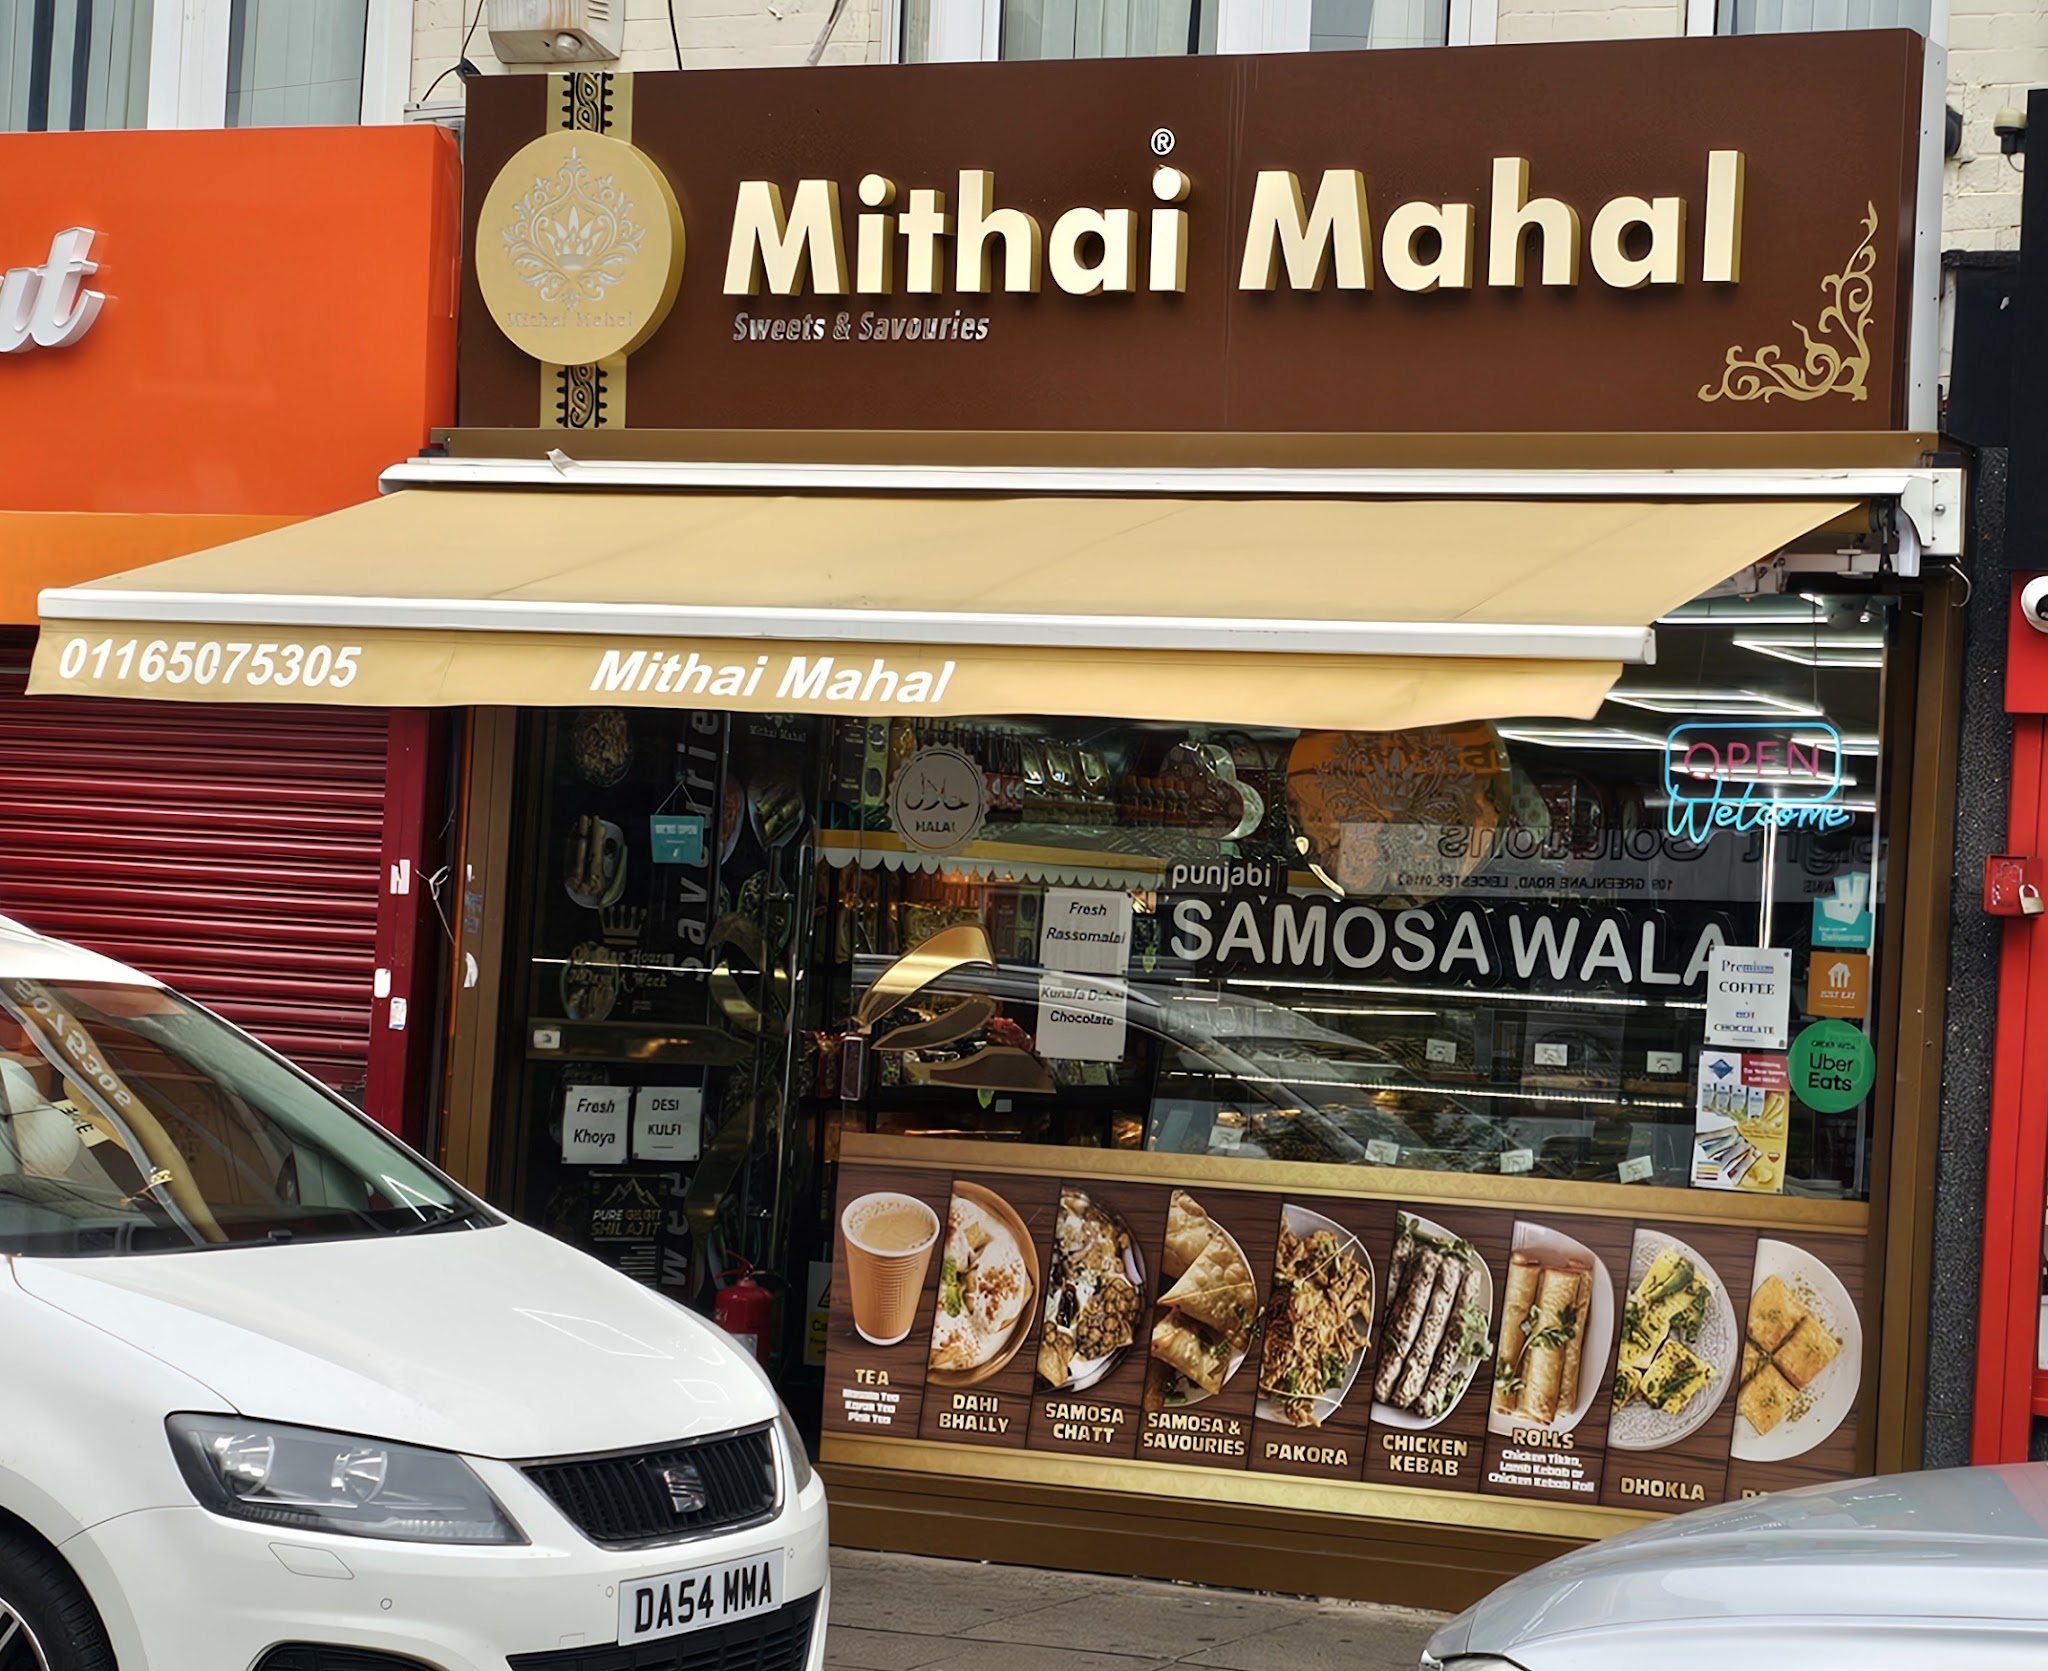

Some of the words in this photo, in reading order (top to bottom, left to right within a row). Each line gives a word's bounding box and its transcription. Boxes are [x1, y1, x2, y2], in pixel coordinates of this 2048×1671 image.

[723, 165, 1191, 296] Mithai
[1238, 150, 1746, 294] Mahal
[507, 312, 567, 328] Mithai
[576, 311, 633, 328] Mahal
[732, 311, 825, 342] Sweets
[832, 311, 852, 341] &
[858, 309, 991, 341] Savouries
[58, 637, 362, 689] 01165075305
[589, 650, 769, 697] Mithai
[776, 655, 956, 703] Mahal
[1683, 741, 1820, 781] OPEN
[1667, 773, 1850, 845] Welcome
[1171, 862, 1272, 892] punjabi
[1069, 902, 1108, 917] Fresh
[1171, 899, 1491, 976] SAMOSA
[1508, 915, 1726, 988] WALA
[1721, 959, 1775, 975] Premium
[1719, 981, 1776, 996] COFFEE
[1050, 1010, 1115, 1026] Chocolate
[1713, 1023, 1776, 1036] CHOCOLATE
[1809, 1052, 1854, 1073] Uber
[1808, 1072, 1852, 1092] Eats
[576, 1098, 616, 1114] Fresh
[651, 1098, 680, 1112] DESI
[573, 1128, 616, 1147] Khoya
[648, 1123, 682, 1137] KULFI
[592, 1208, 624, 1222] PURE
[855, 1368, 890, 1386] TEA
[952, 1393, 999, 1413] DAHI
[1045, 1402, 1125, 1425] SAMOSA
[938, 1412, 1010, 1435] BHALLY
[1052, 1423, 1116, 1444] CHATT
[1147, 1412, 1224, 1435] SAMOSA
[1227, 1418, 1241, 1436] &
[1142, 1433, 1246, 1457] SAVOURIES
[1382, 1433, 1468, 1458] CHICKEN
[1512, 1427, 1575, 1450] ROLLS
[1265, 1442, 1349, 1467] PAKORA
[1389, 1454, 1459, 1477] KEBAB
[1501, 1449, 1547, 1464] Chicken
[1488, 1472, 1533, 1486] Chicken
[1620, 1476, 1706, 1501] DHOKLA
[633, 1575, 714, 1634] DA54
[723, 1561, 773, 1615] MMA
